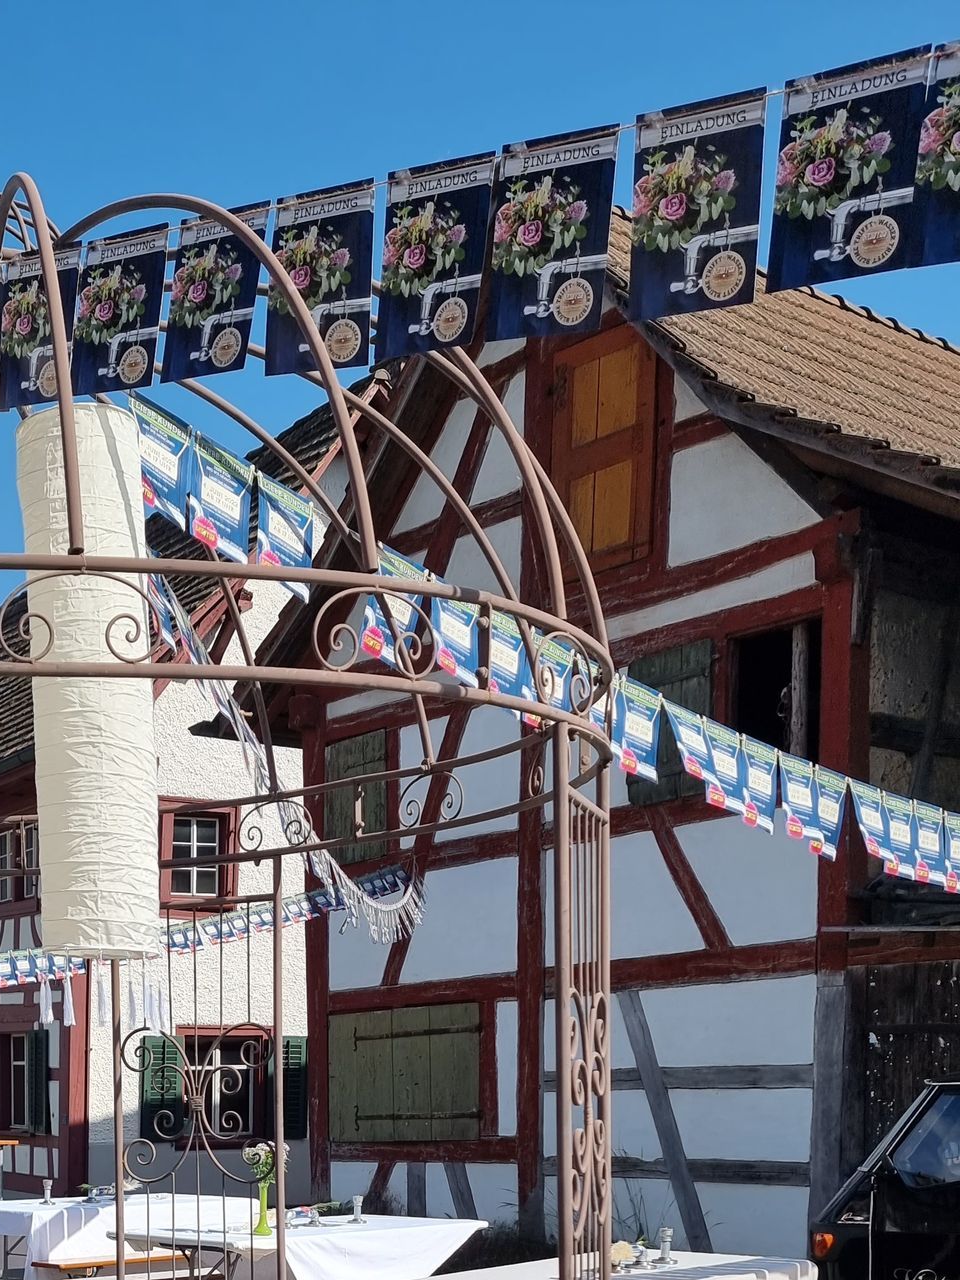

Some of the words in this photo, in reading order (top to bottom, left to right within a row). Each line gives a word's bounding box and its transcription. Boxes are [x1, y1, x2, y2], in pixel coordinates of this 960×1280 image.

[810, 70, 907, 105] EINLADUNG
[660, 110, 746, 140] EINLADUNG
[522, 144, 600, 169] EINLADUNG
[407, 171, 478, 192] EINLADUNG
[294, 196, 358, 220] EINLADUNG
[854, 220, 873, 244] TRIFFT
[878, 218, 897, 240] WASSER
[100, 240, 156, 260] EINLADUNG
[872, 241, 895, 264] TRIFFT
[706, 256, 723, 280] TRIFFT
[726, 254, 744, 276] WASSER
[722, 278, 743, 298] TRIFFT
